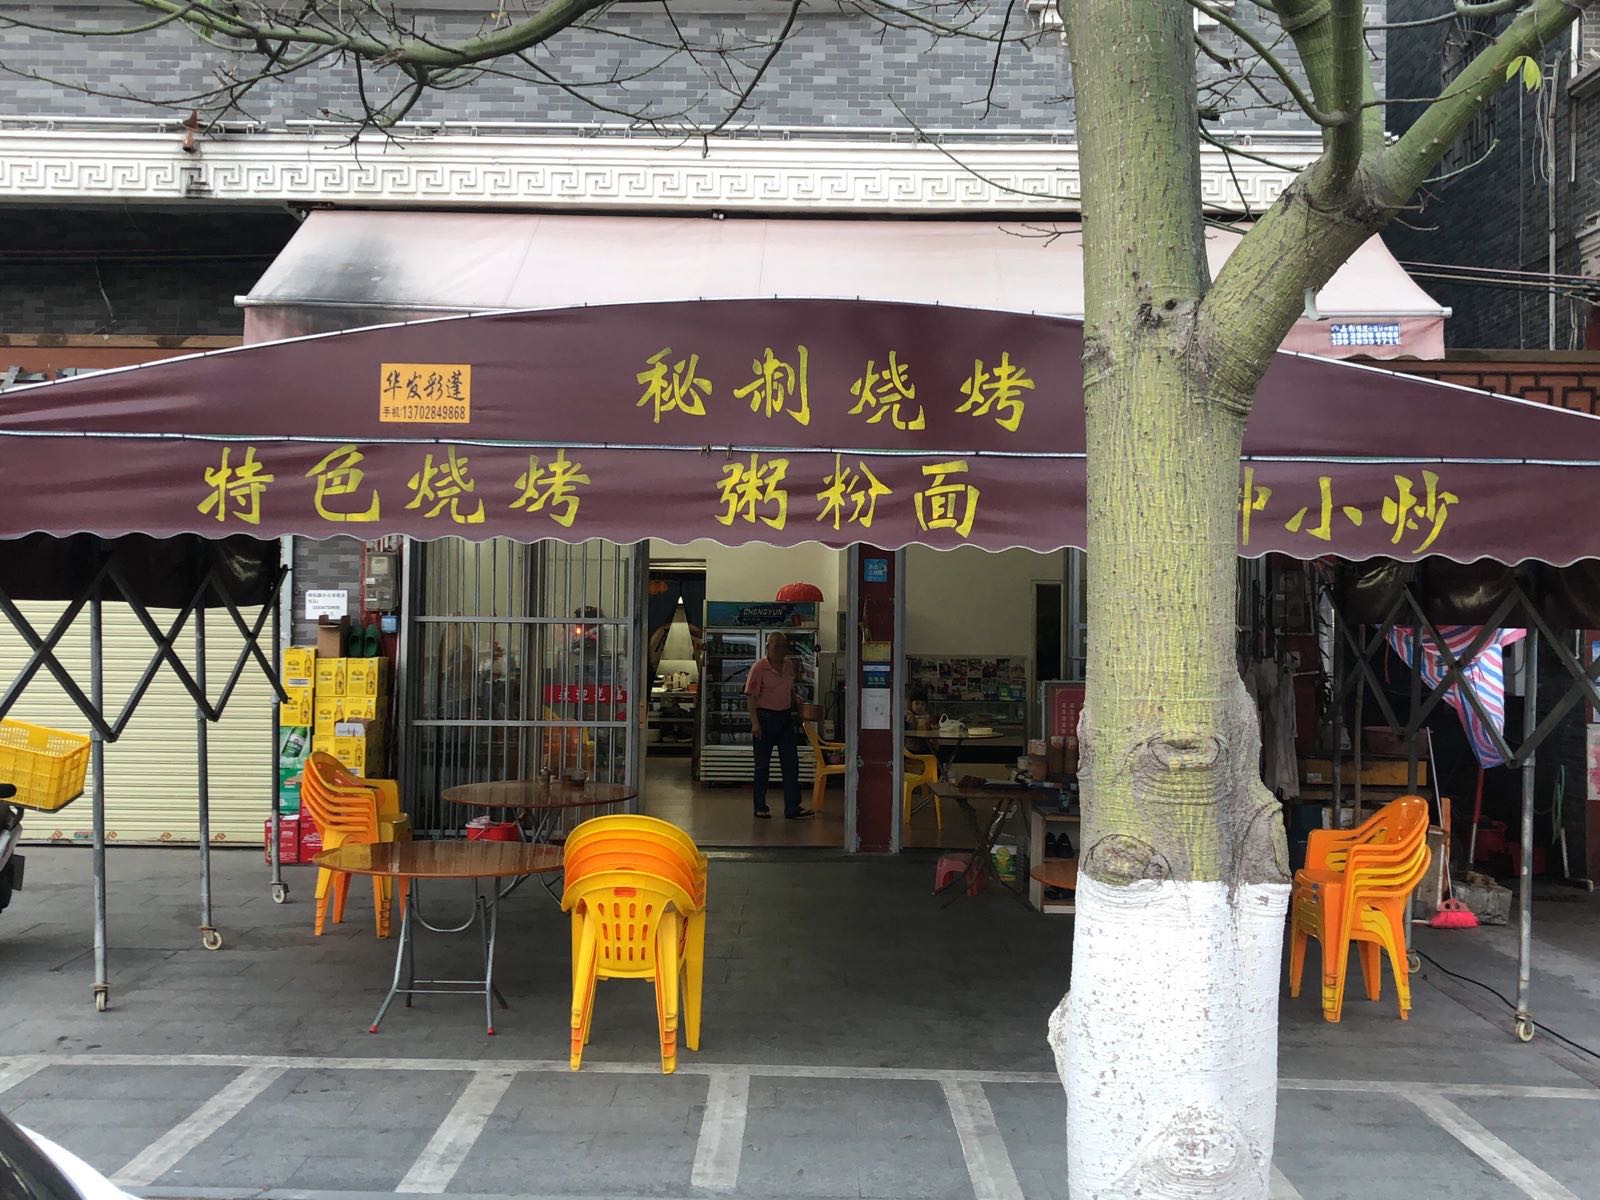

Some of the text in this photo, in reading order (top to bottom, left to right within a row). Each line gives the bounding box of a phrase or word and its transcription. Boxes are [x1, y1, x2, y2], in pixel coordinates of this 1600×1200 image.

[403, 405, 466, 420] 13702849868
[636, 345, 1035, 432] 秘制烧烤
[197, 444, 591, 528] 特色烧烤
[713, 452, 980, 538] 粥粉面
